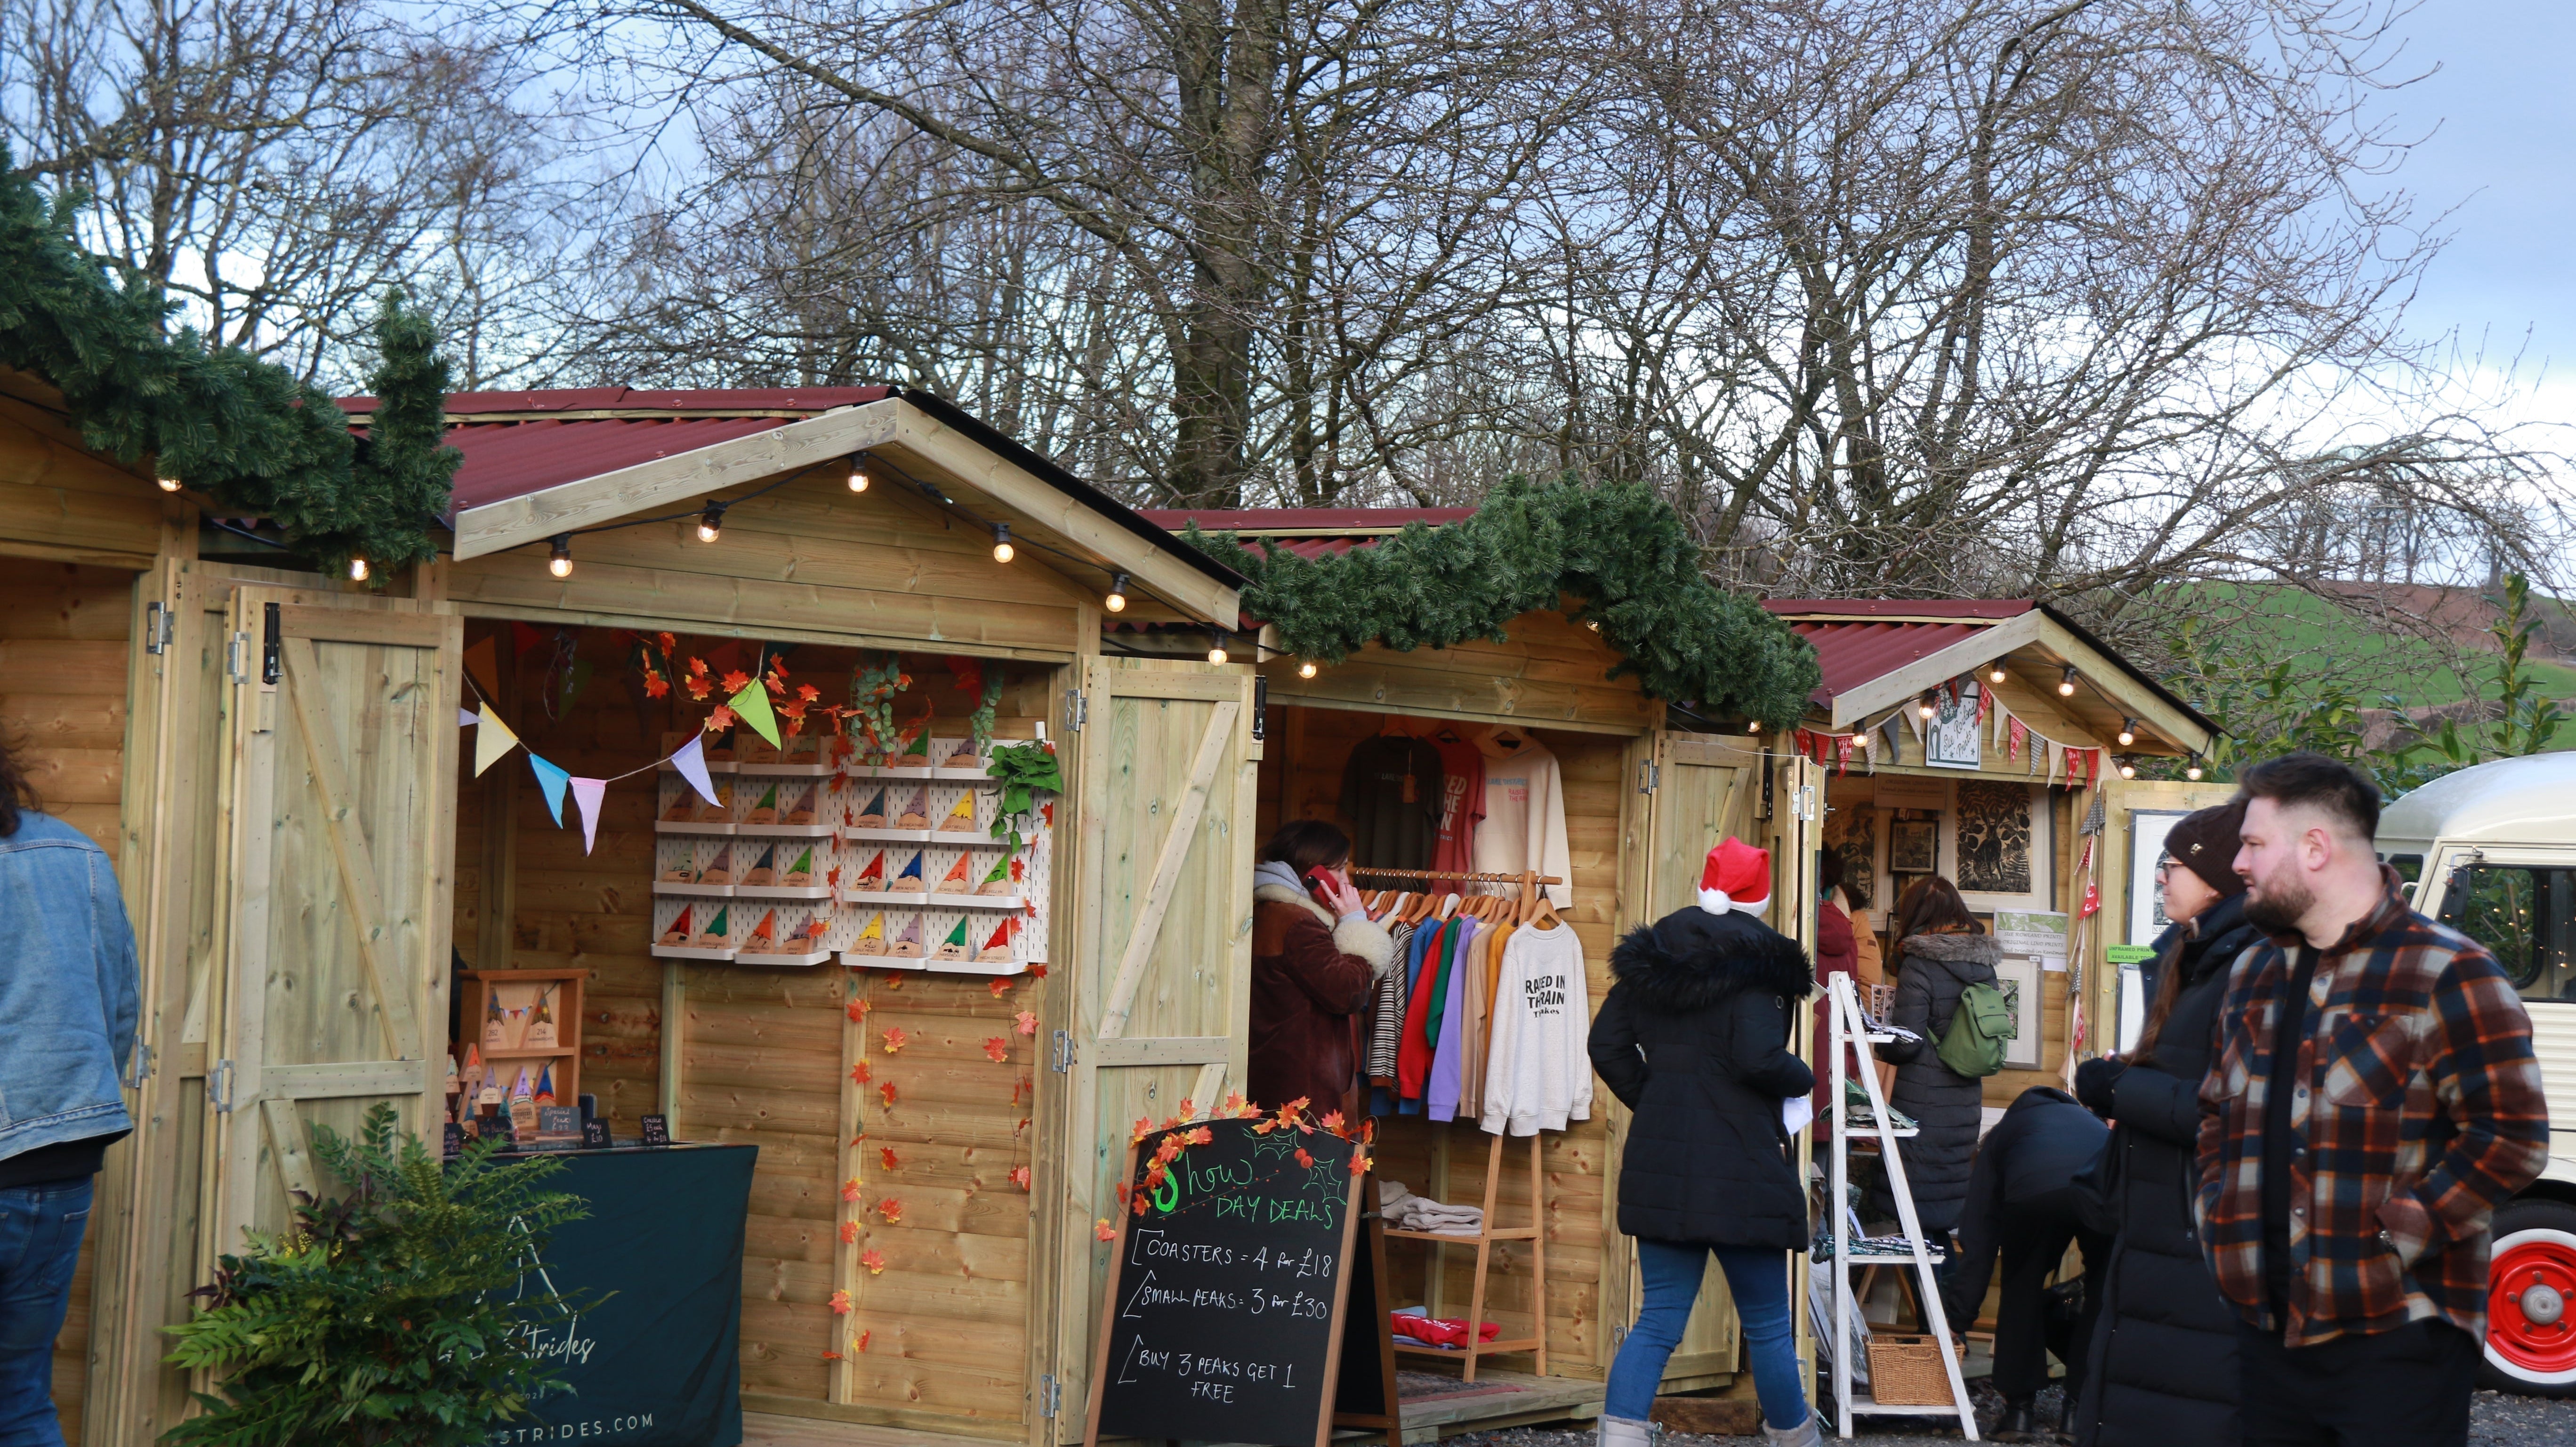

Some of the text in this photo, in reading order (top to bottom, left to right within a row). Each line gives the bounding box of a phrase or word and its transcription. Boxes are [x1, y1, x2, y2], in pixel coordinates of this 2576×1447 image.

[1943, 700, 1976, 752] Sue Rowland
[1956, 731, 1972, 758] Prints
[1443, 793, 1461, 813] HE
[1556, 975, 1565, 989] IN
[1527, 996, 1540, 1008] TH
[545, 1107, 570, 1117] Special
[552, 1116, 571, 1124] Peaks
[587, 1122, 602, 1133] Mugs
[591, 1133, 603, 1143] £10
[646, 1124, 653, 1132] £5
[1217, 1196, 1333, 1230] DAY DEALS
[1147, 1239, 1232, 1265] COASTERS
[1253, 1246, 1268, 1271] 4
[1278, 1252, 1295, 1268] for
[1296, 1248, 1332, 1278] £18
[1142, 1286, 1190, 1305] SMALL
[1251, 1288, 1265, 1314] 3
[1272, 1294, 1288, 1307] for
[1291, 1291, 1327, 1318] £30
[1139, 1350, 1296, 1388] BUY 3 PEAKS GET 1
[1191, 1381, 1234, 1403] FREE
[485, 1413, 652, 1445] STRIDES.COM
